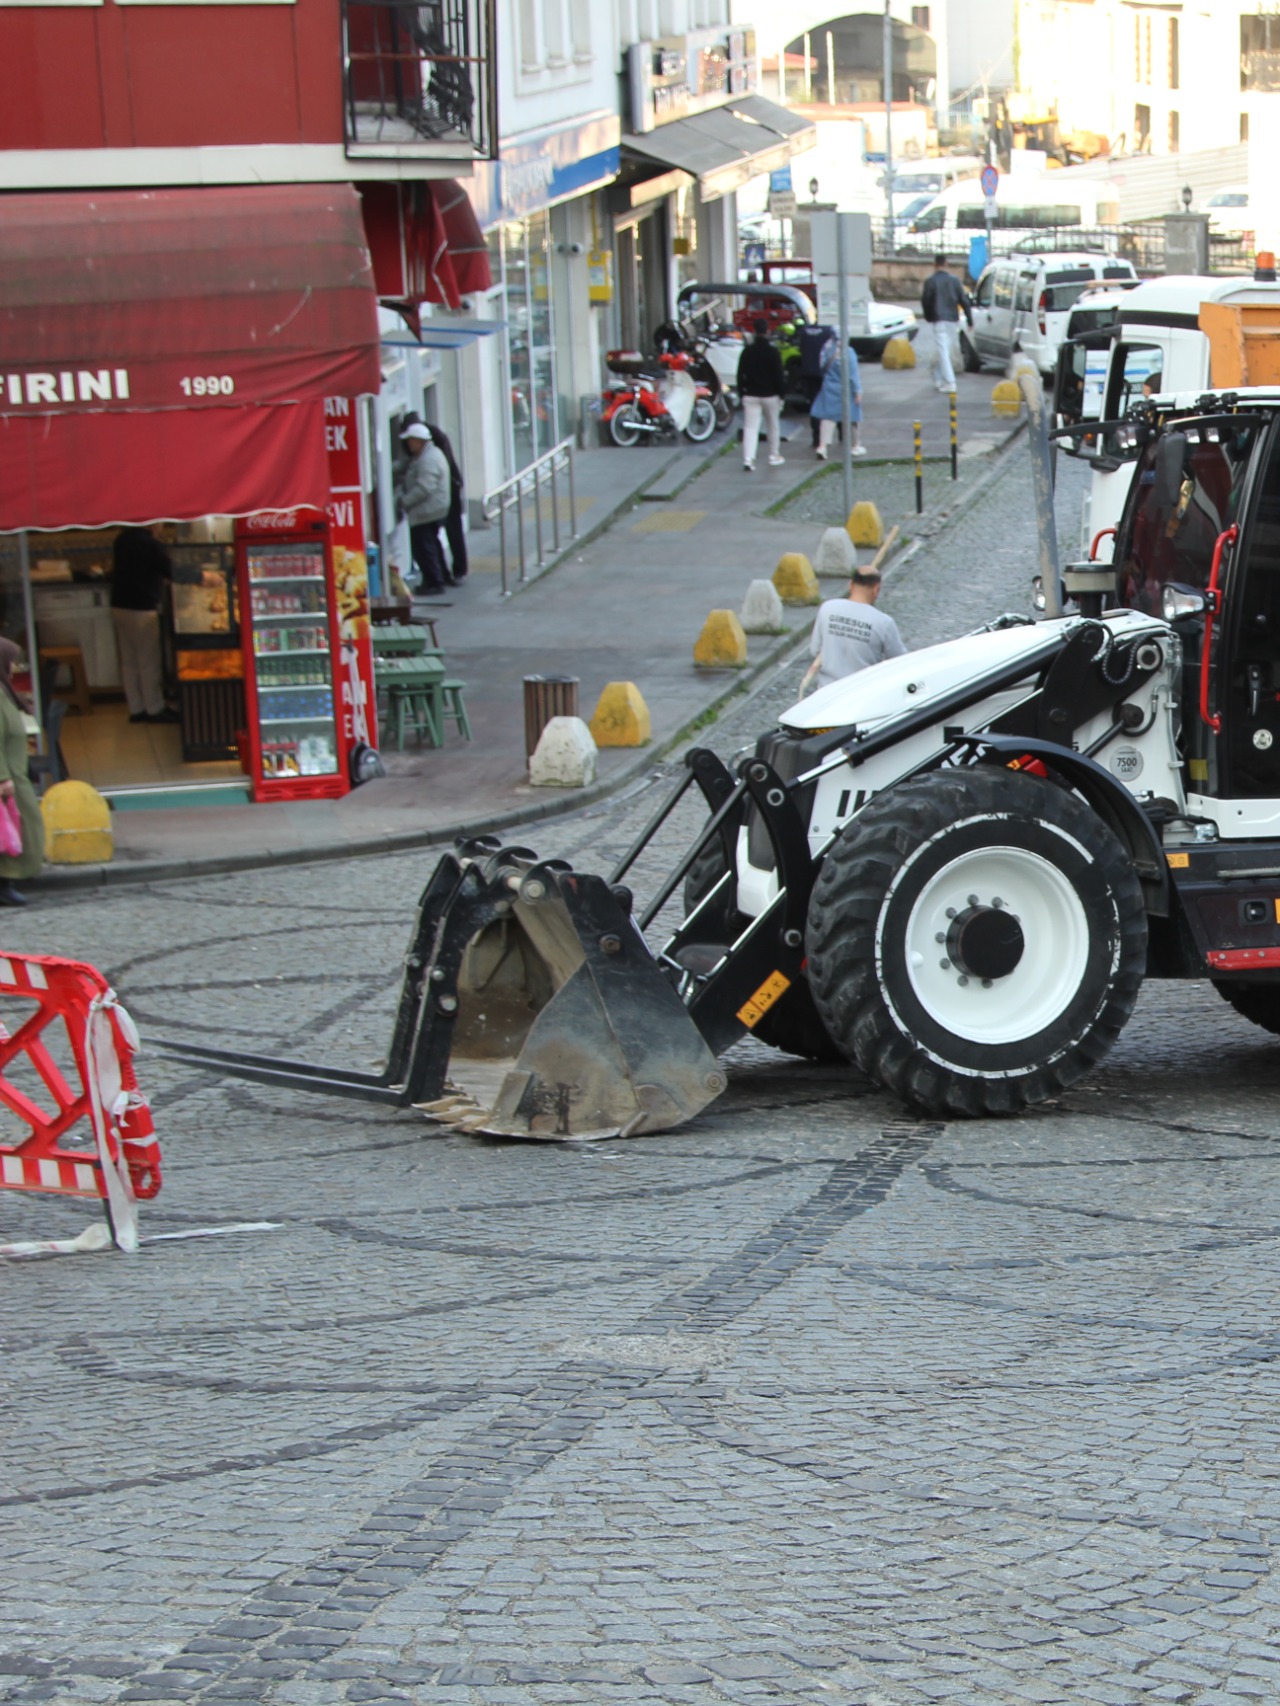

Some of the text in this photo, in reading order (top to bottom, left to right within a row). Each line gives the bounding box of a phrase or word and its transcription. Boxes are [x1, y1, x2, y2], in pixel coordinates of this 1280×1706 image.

[0, 369, 235, 405] IRINI 1990
[1117, 757, 1138, 767] 7500
